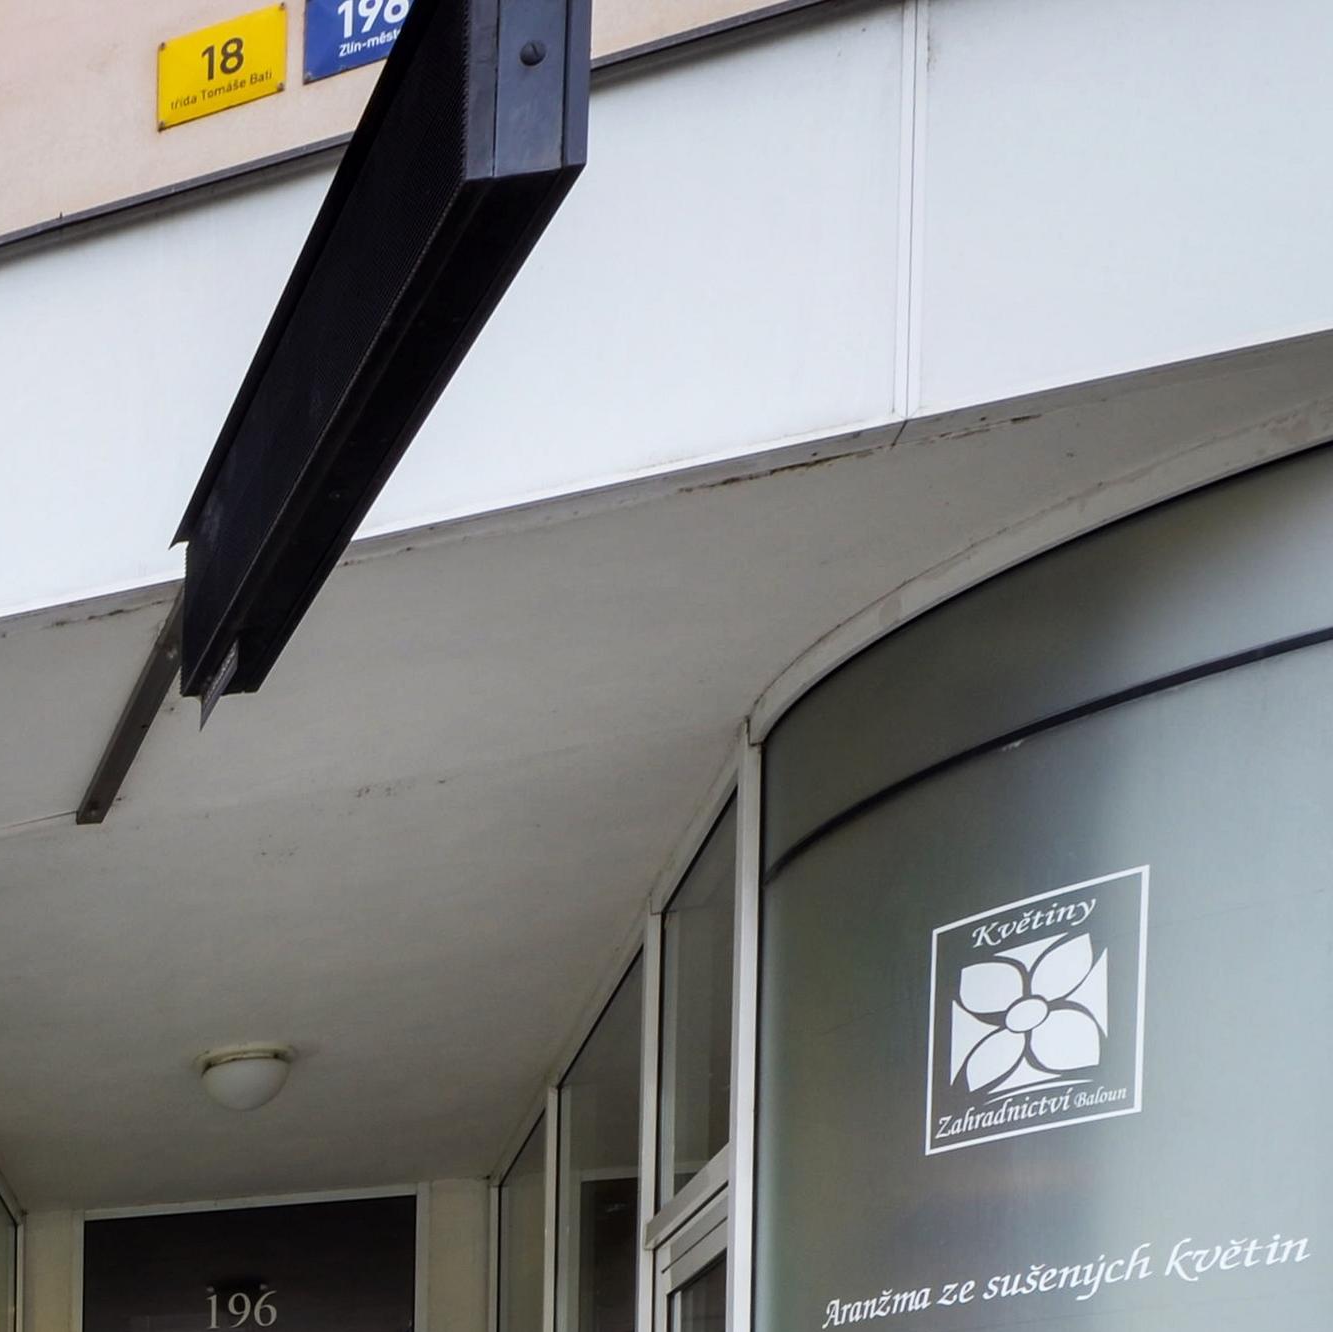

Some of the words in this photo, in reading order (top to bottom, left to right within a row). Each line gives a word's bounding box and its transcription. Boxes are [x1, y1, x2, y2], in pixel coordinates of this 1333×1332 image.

[338, 0, 410, 38] 196
[201, 37, 244, 81] 18
[339, 28, 401, 57] Zlín-měst
[170, 95, 198, 111] třída
[201, 78, 247, 101] Tomáše
[249, 71, 273, 87] Bati
[971, 898, 1097, 948] Květiny
[935, 1088, 1072, 1139] Zahradnictví
[1073, 1086, 1127, 1108] Baloun
[822, 1285, 931, 1329] Aranžma
[937, 1280, 975, 1306] ze
[983, 1242, 1153, 1300] sušených
[1165, 1233, 1310, 1282] květin
[206, 1290, 278, 1330] 196
